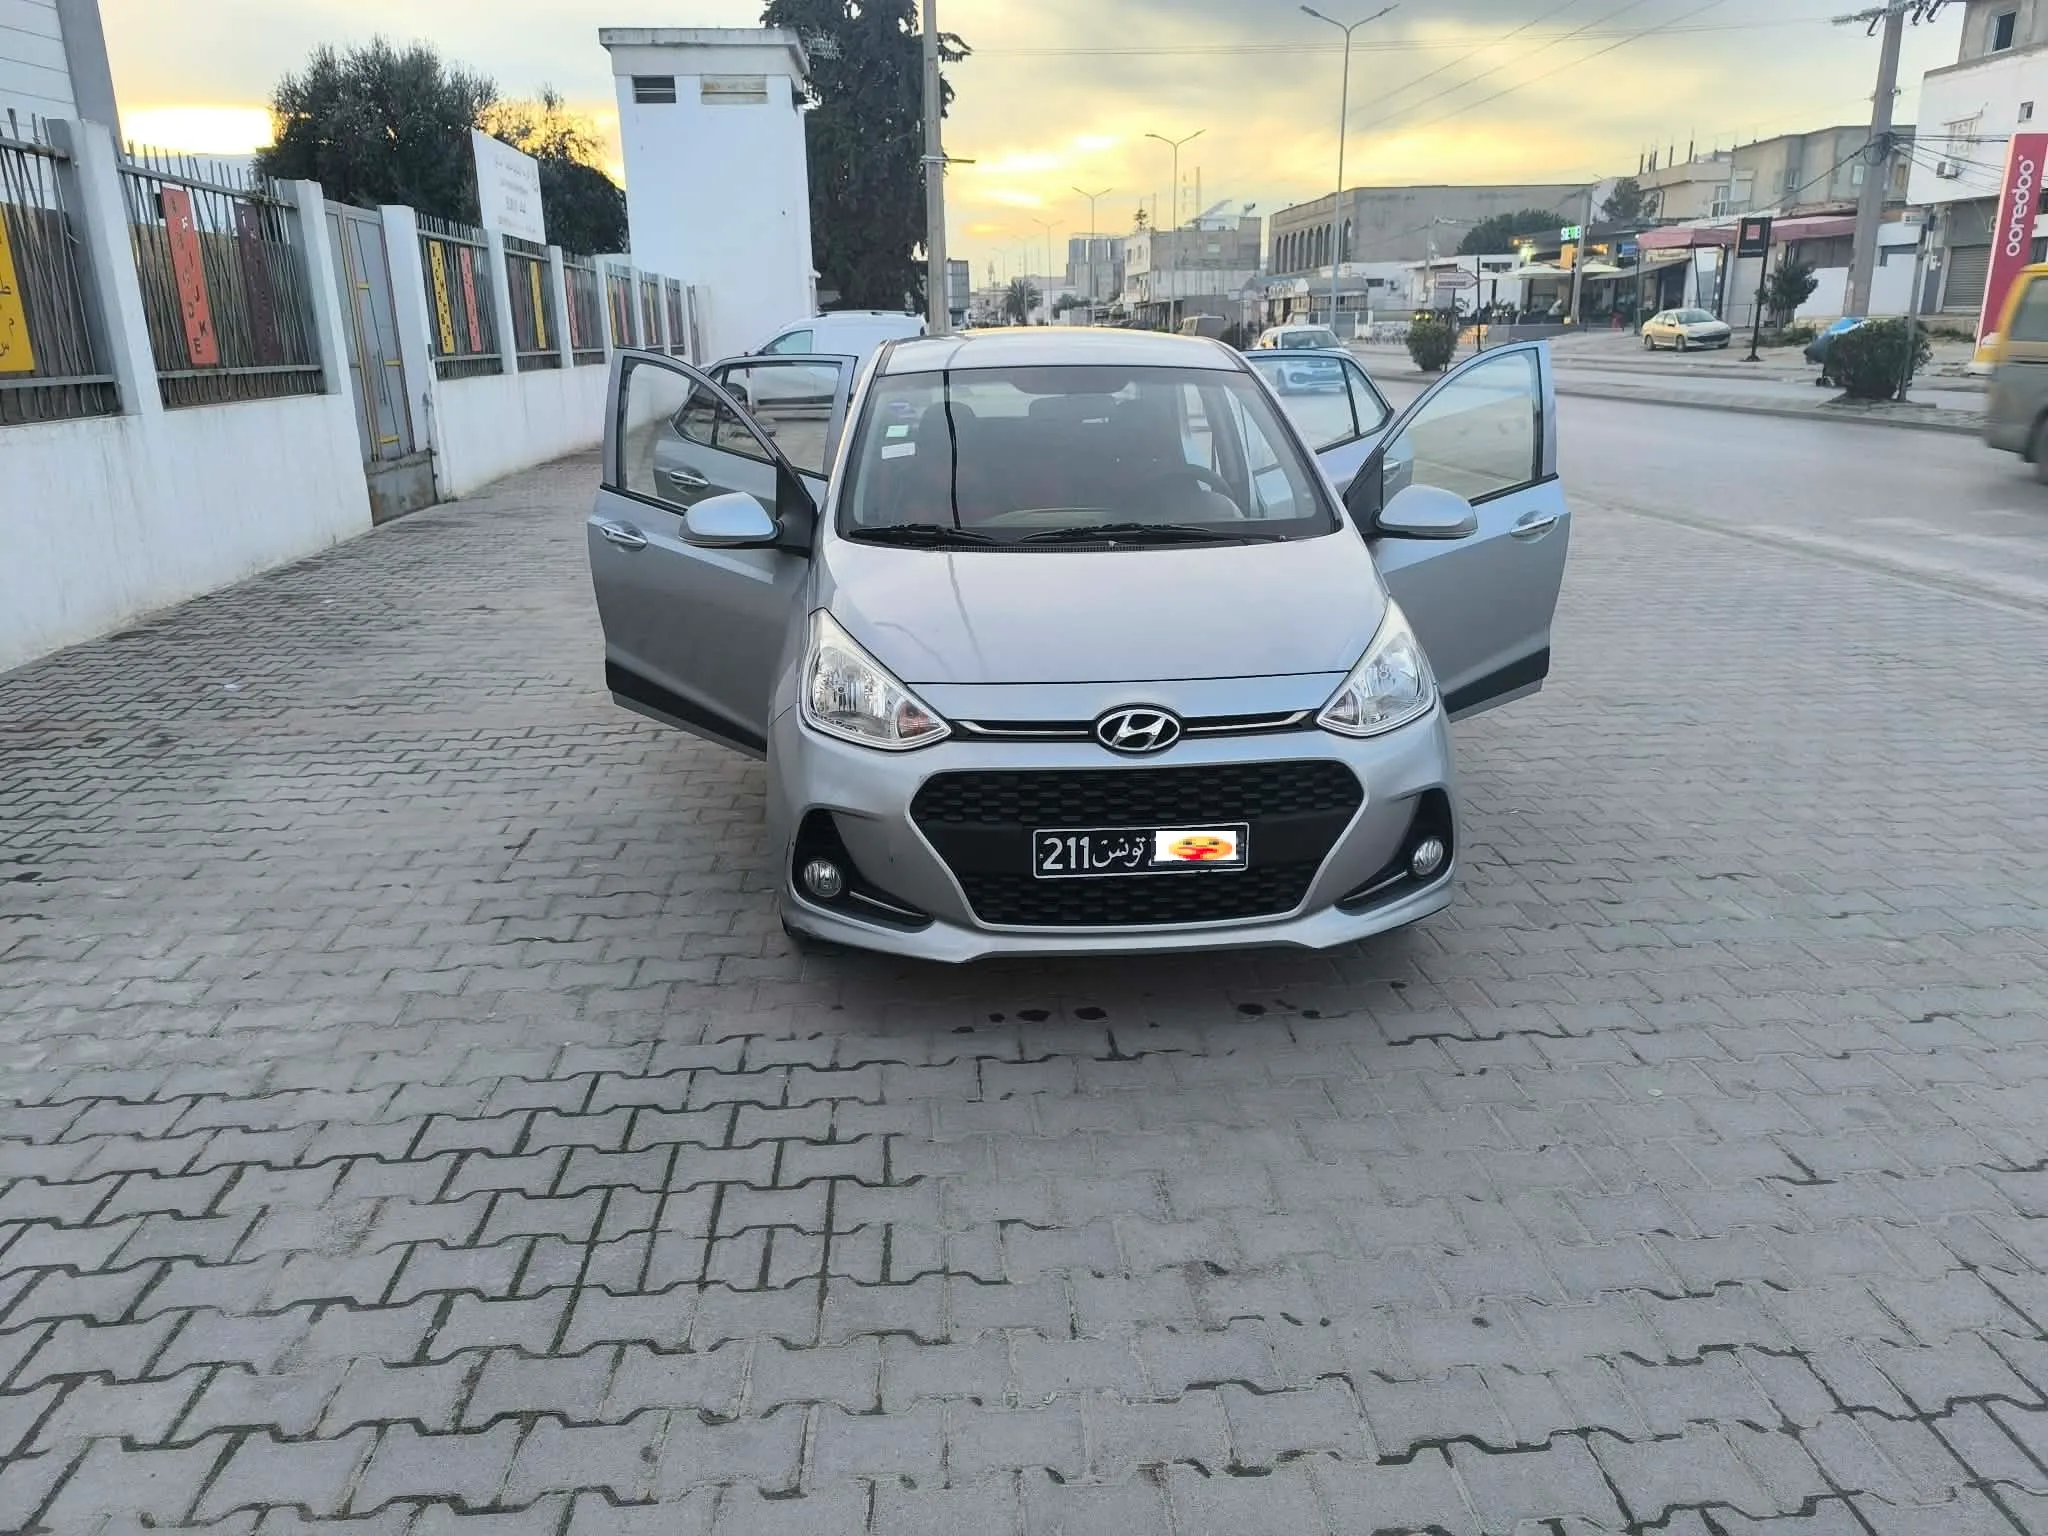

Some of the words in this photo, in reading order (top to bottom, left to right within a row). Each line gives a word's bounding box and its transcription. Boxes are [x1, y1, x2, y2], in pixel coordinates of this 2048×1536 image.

[2006, 155, 2035, 257] ooredoo
[1042, 836, 1090, 870] 211
[1092, 837, 1146, 868] تونس
